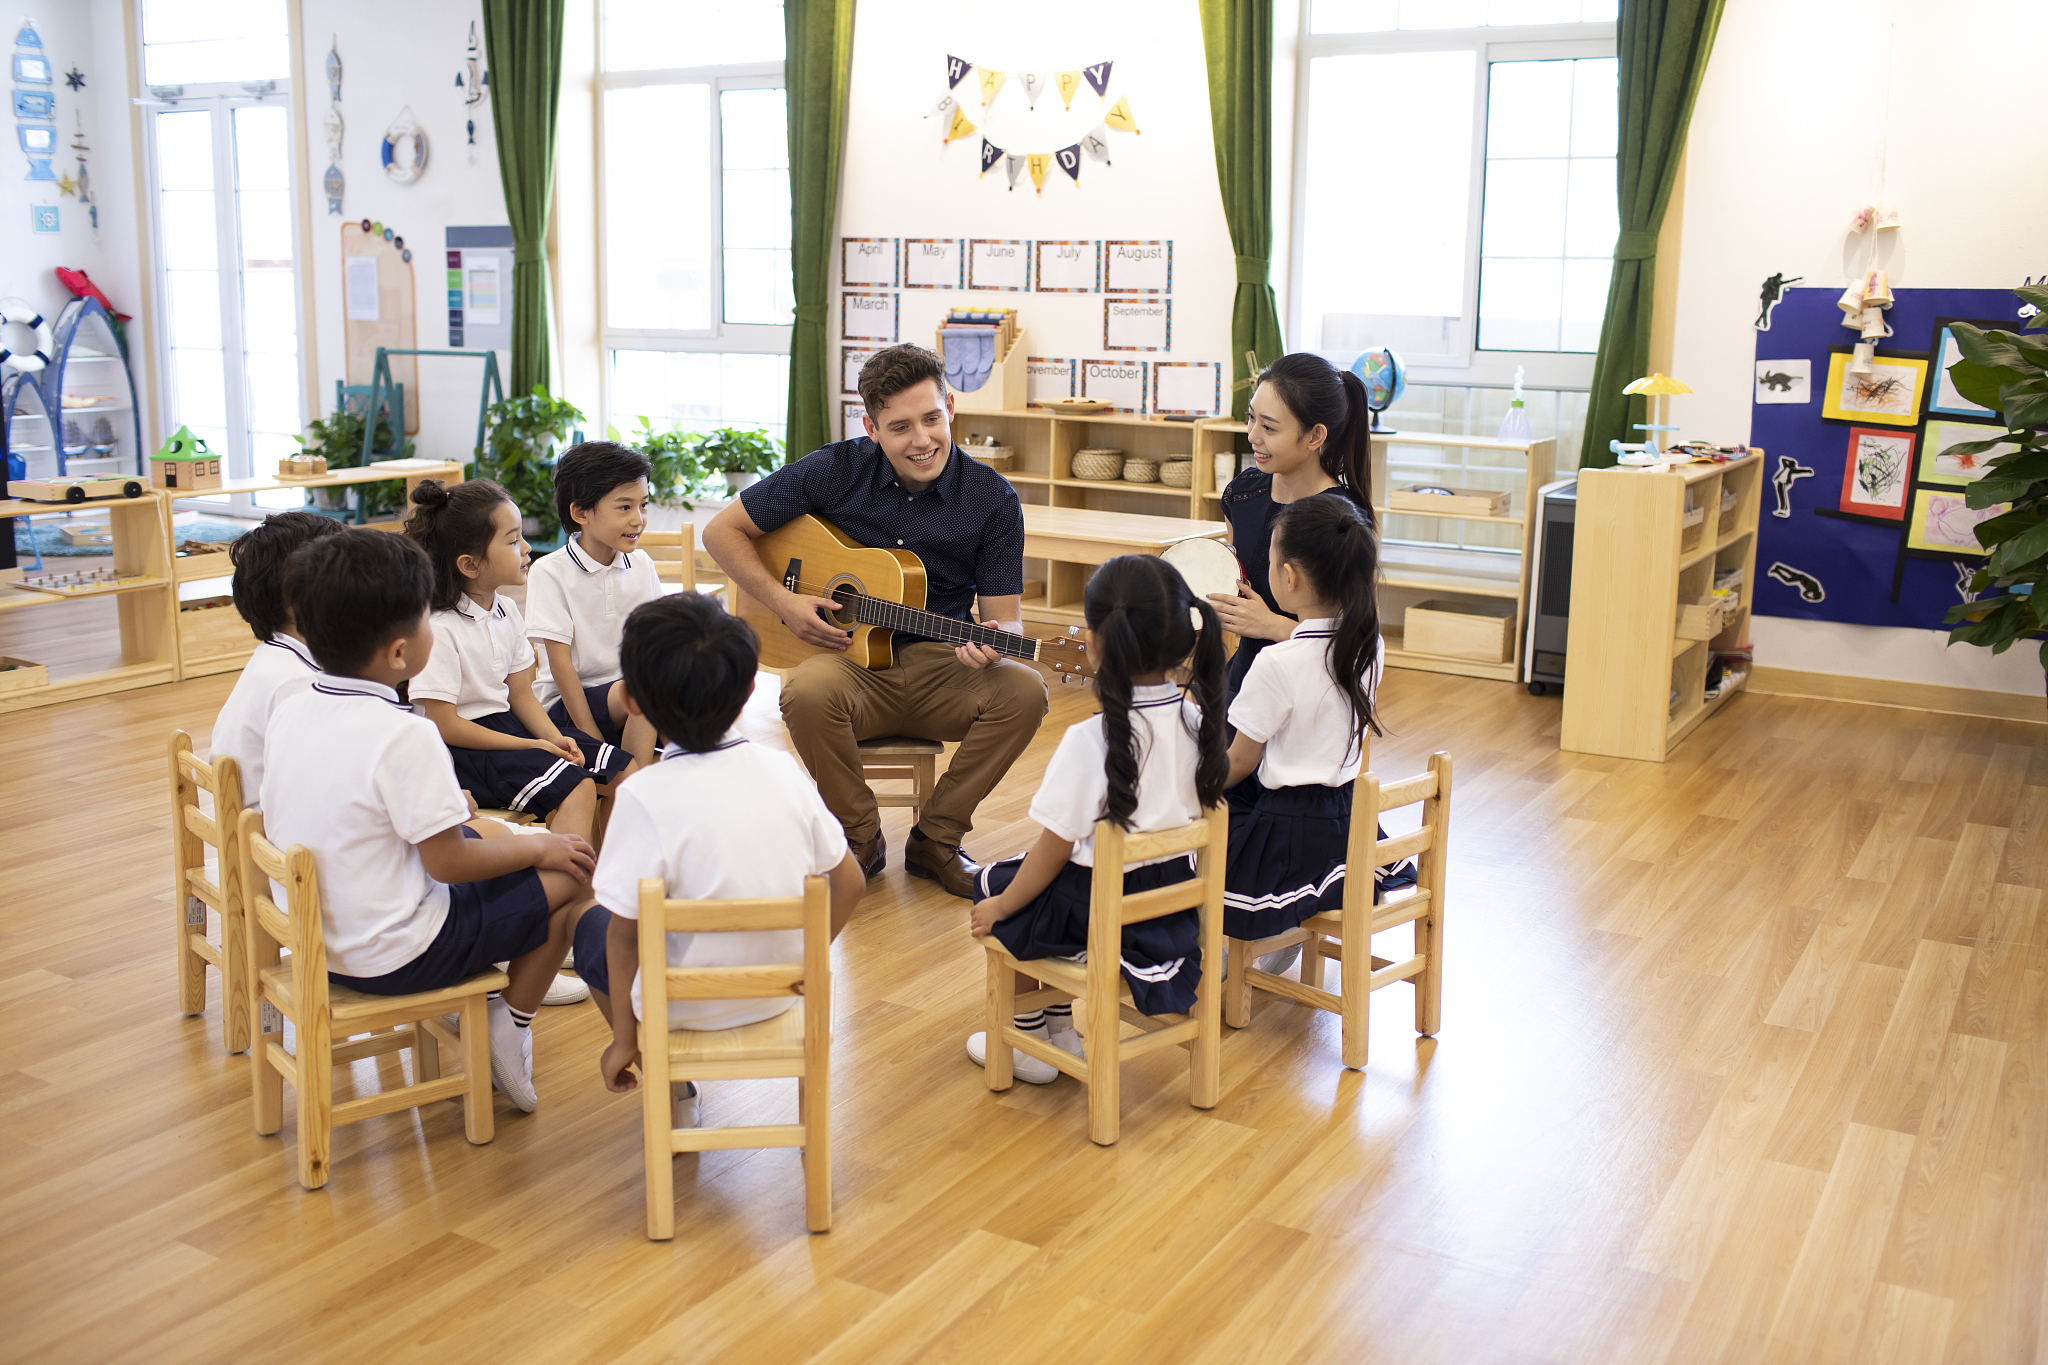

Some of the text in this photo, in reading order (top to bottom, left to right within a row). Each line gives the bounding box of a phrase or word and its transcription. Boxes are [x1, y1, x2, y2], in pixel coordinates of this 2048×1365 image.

[949, 58, 1104, 92] HAPPY
[937, 96, 1127, 175] BIRTHDAY
[858, 243, 883, 256] April
[923, 244, 947, 259] May
[986, 245, 1015, 258] June
[1057, 246, 1081, 261] July
[1117, 246, 1162, 261] August
[853, 298, 888, 310] March
[1113, 306, 1164, 317] September
[1027, 365, 1070, 376] ovember
[1090, 365, 1140, 379] October
